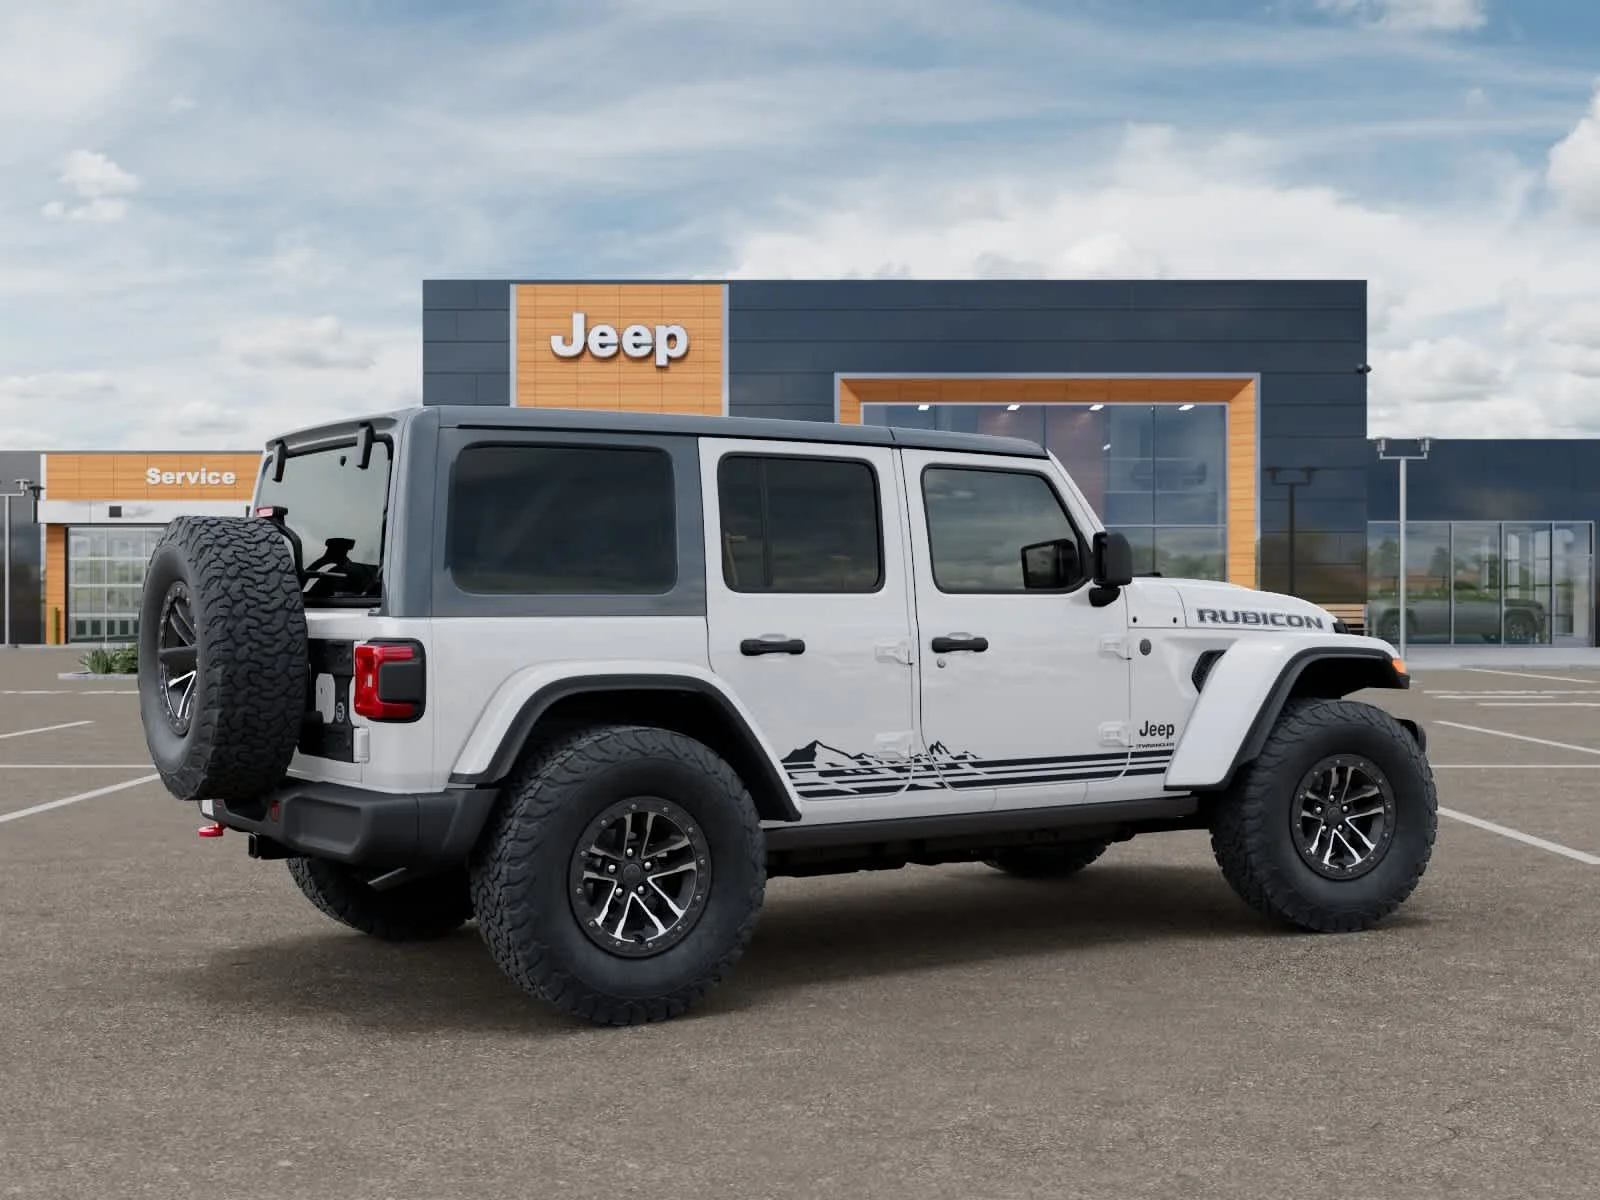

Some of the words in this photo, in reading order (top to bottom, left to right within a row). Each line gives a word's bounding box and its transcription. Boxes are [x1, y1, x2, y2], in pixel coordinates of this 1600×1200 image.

[551, 312, 688, 367] Jeep
[146, 466, 236, 485] Service
[1197, 608, 1323, 629] RUBICON
[1139, 720, 1175, 740] Jeep
